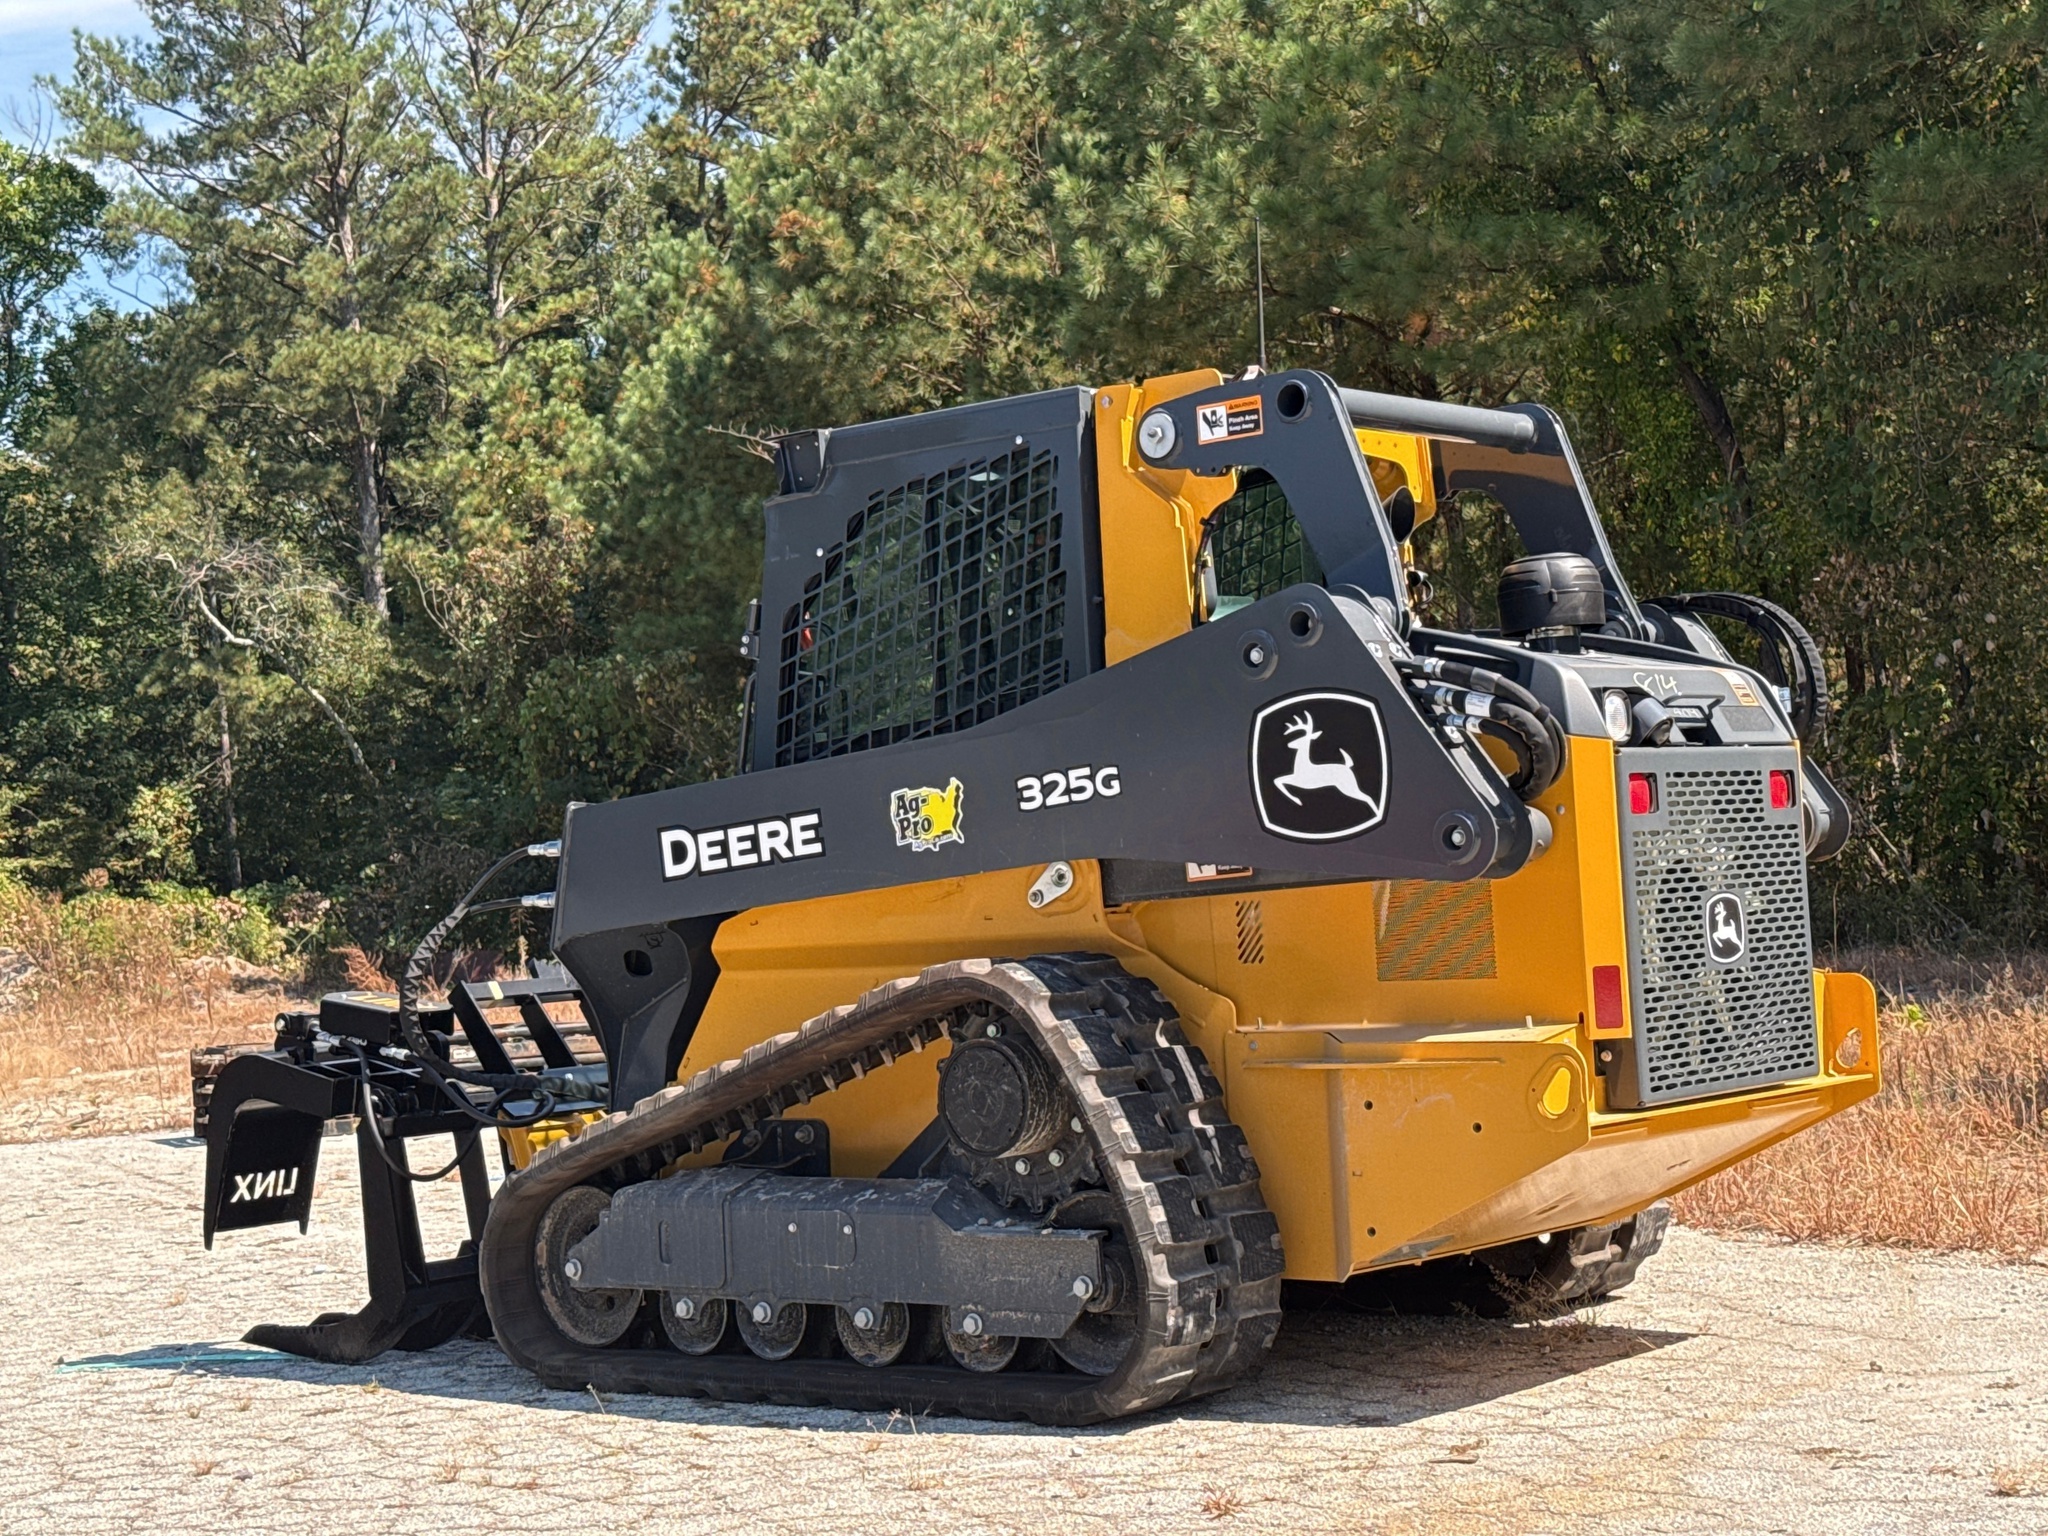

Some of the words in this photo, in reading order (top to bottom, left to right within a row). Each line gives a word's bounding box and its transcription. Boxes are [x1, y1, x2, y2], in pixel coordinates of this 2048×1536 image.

[1017, 766, 1122, 811] 325G
[660, 813, 823, 878] DEERE
[897, 816, 932, 841] Pro
